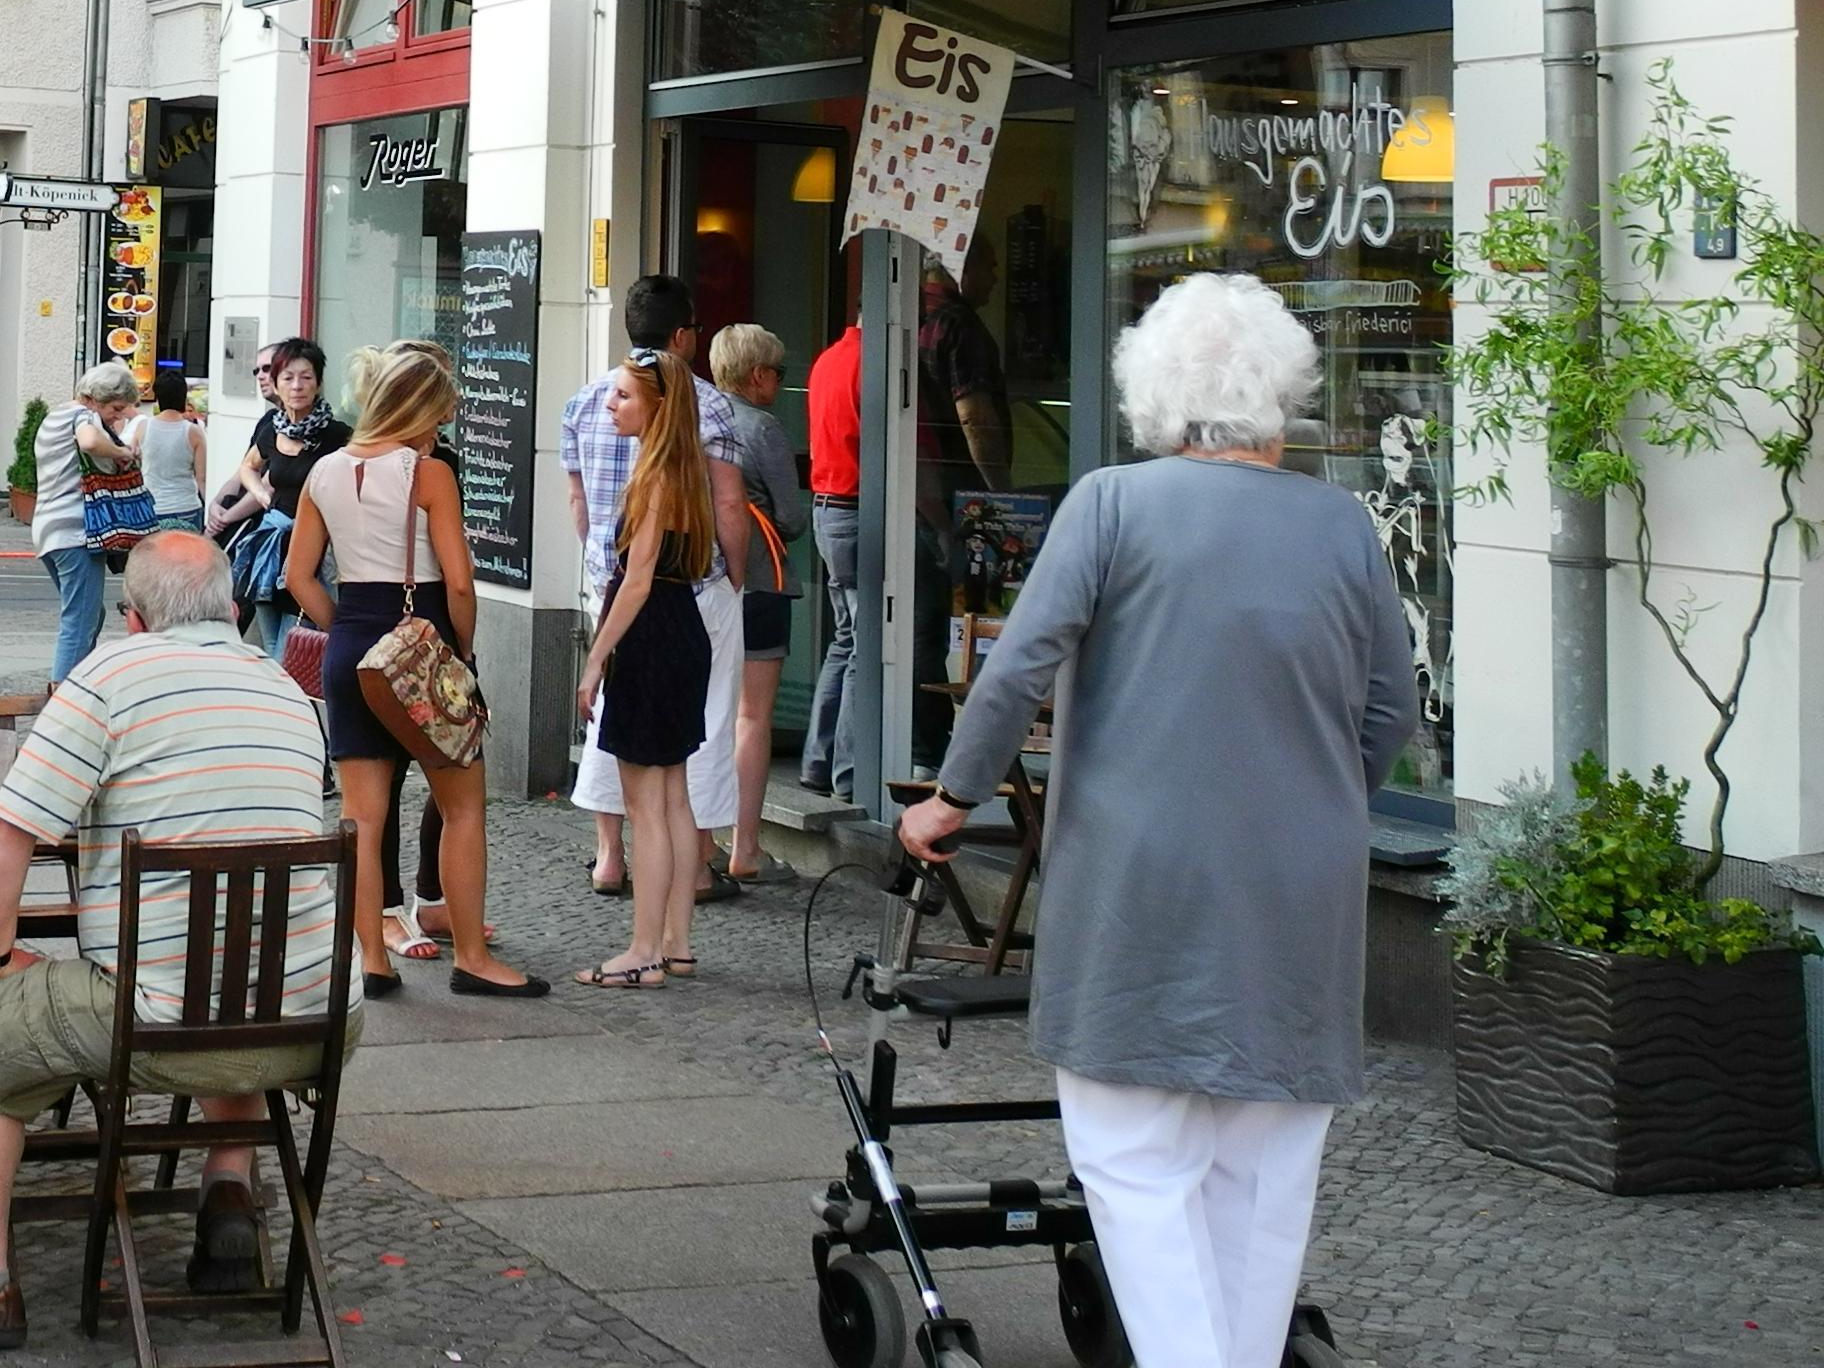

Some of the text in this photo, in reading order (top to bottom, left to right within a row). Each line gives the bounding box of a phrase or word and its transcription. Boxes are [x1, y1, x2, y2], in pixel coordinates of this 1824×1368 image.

[895, 22, 991, 103] Eis
[360, 133, 445, 192] Roger
[1190, 82, 1433, 188] Hausgemachtes
[12, 184, 99, 203] lt-Köpenick
[1282, 150, 1395, 260] Eis
[508, 237, 529, 278] Eis
